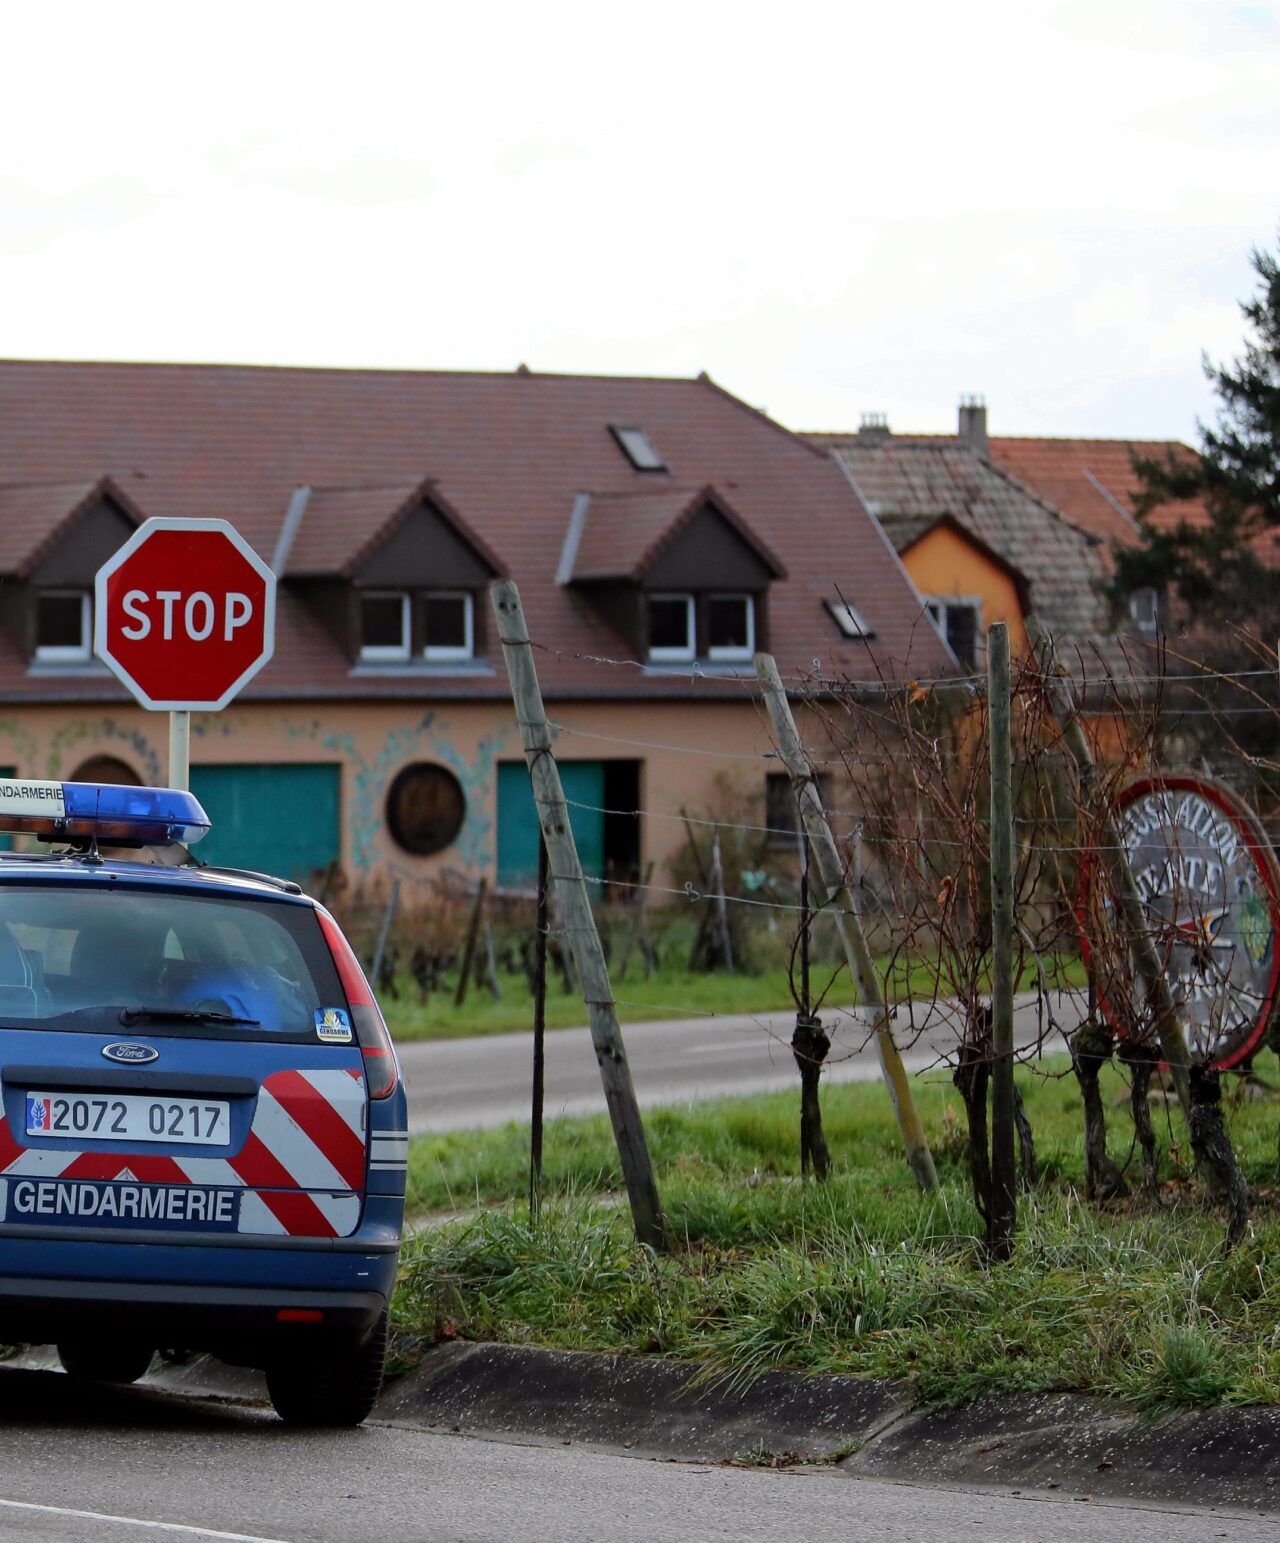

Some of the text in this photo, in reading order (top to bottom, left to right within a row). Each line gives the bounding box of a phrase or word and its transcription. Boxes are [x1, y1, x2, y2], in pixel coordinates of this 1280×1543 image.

[121, 589, 253, 641] STOP
[116, 1045, 146, 1058] Ford
[53, 1099, 221, 1138] 2072 0217
[14, 1181, 234, 1222] GENDARMERIE
